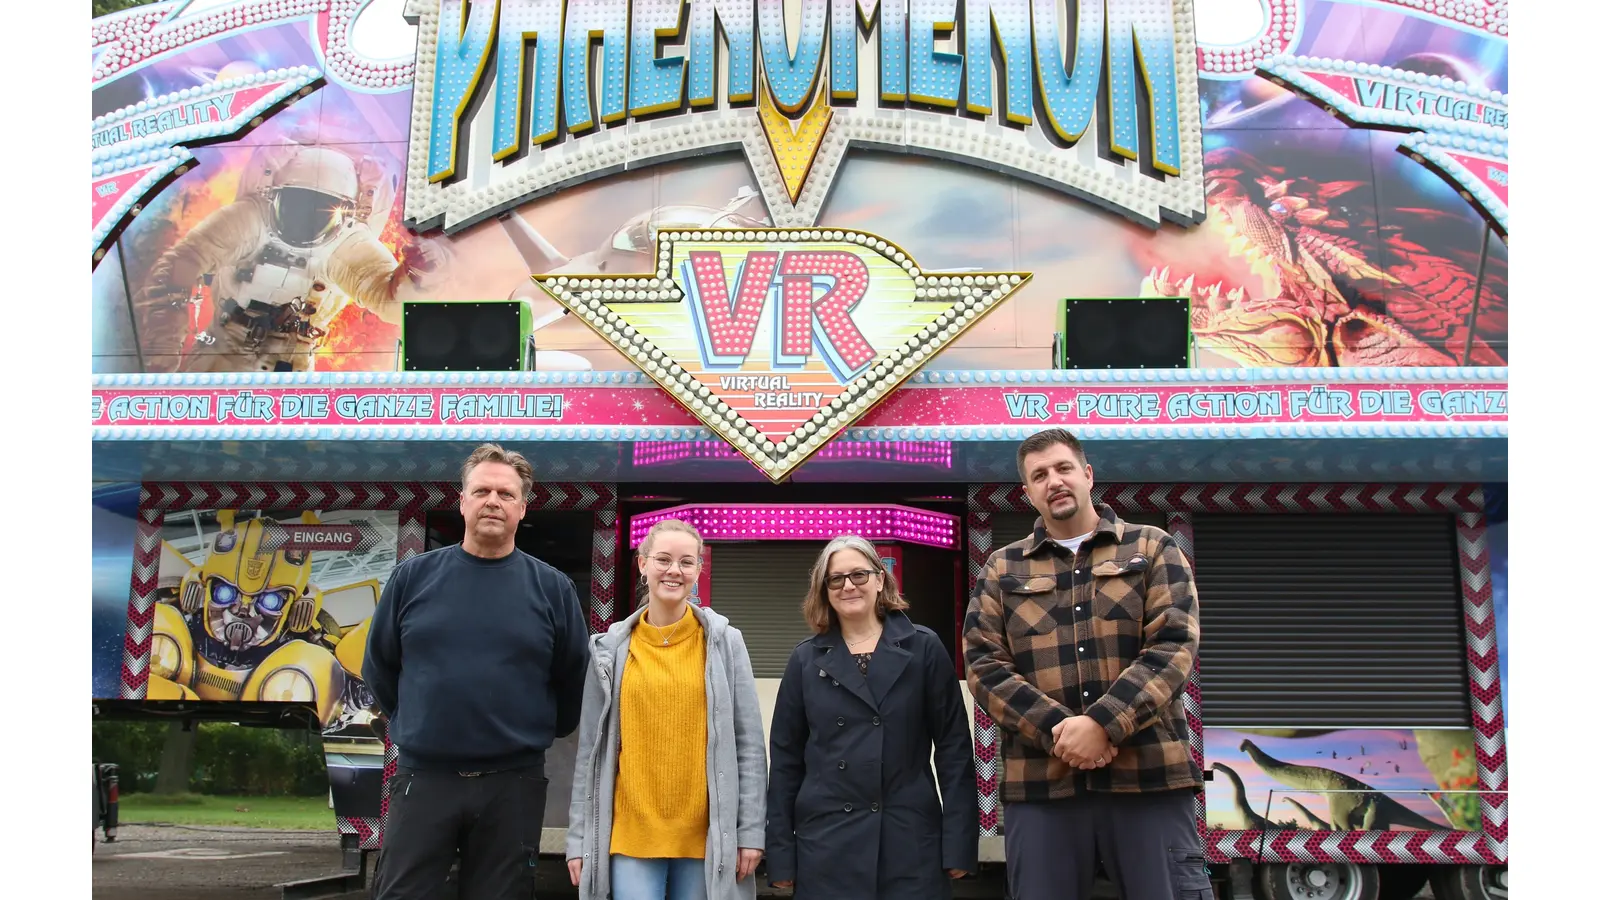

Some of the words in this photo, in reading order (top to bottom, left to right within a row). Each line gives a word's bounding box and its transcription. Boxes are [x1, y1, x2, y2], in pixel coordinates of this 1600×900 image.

[1354, 77, 1480, 121] VIRTUAL
[131, 93, 234, 139] REALITY
[95, 182, 118, 197] VR
[683, 251, 877, 379] VR
[720, 376, 791, 391] VIRTUAL
[109, 396, 209, 421] ACTION
[217, 391, 275, 421] FÜR
[281, 396, 329, 418] DIE
[335, 395, 433, 420] GANZE
[440, 395, 562, 420] FAMILIE!
[753, 392, 823, 408] REALITY
[1005, 394, 1050, 419] VR
[1077, 394, 1160, 420] PURE
[1168, 393, 1280, 420] ACTION
[1289, 387, 1353, 417] FÜR
[1360, 391, 1412, 414] DIE
[1420, 391, 1508, 416] GANZ
[294, 532, 352, 543] EINGANG
